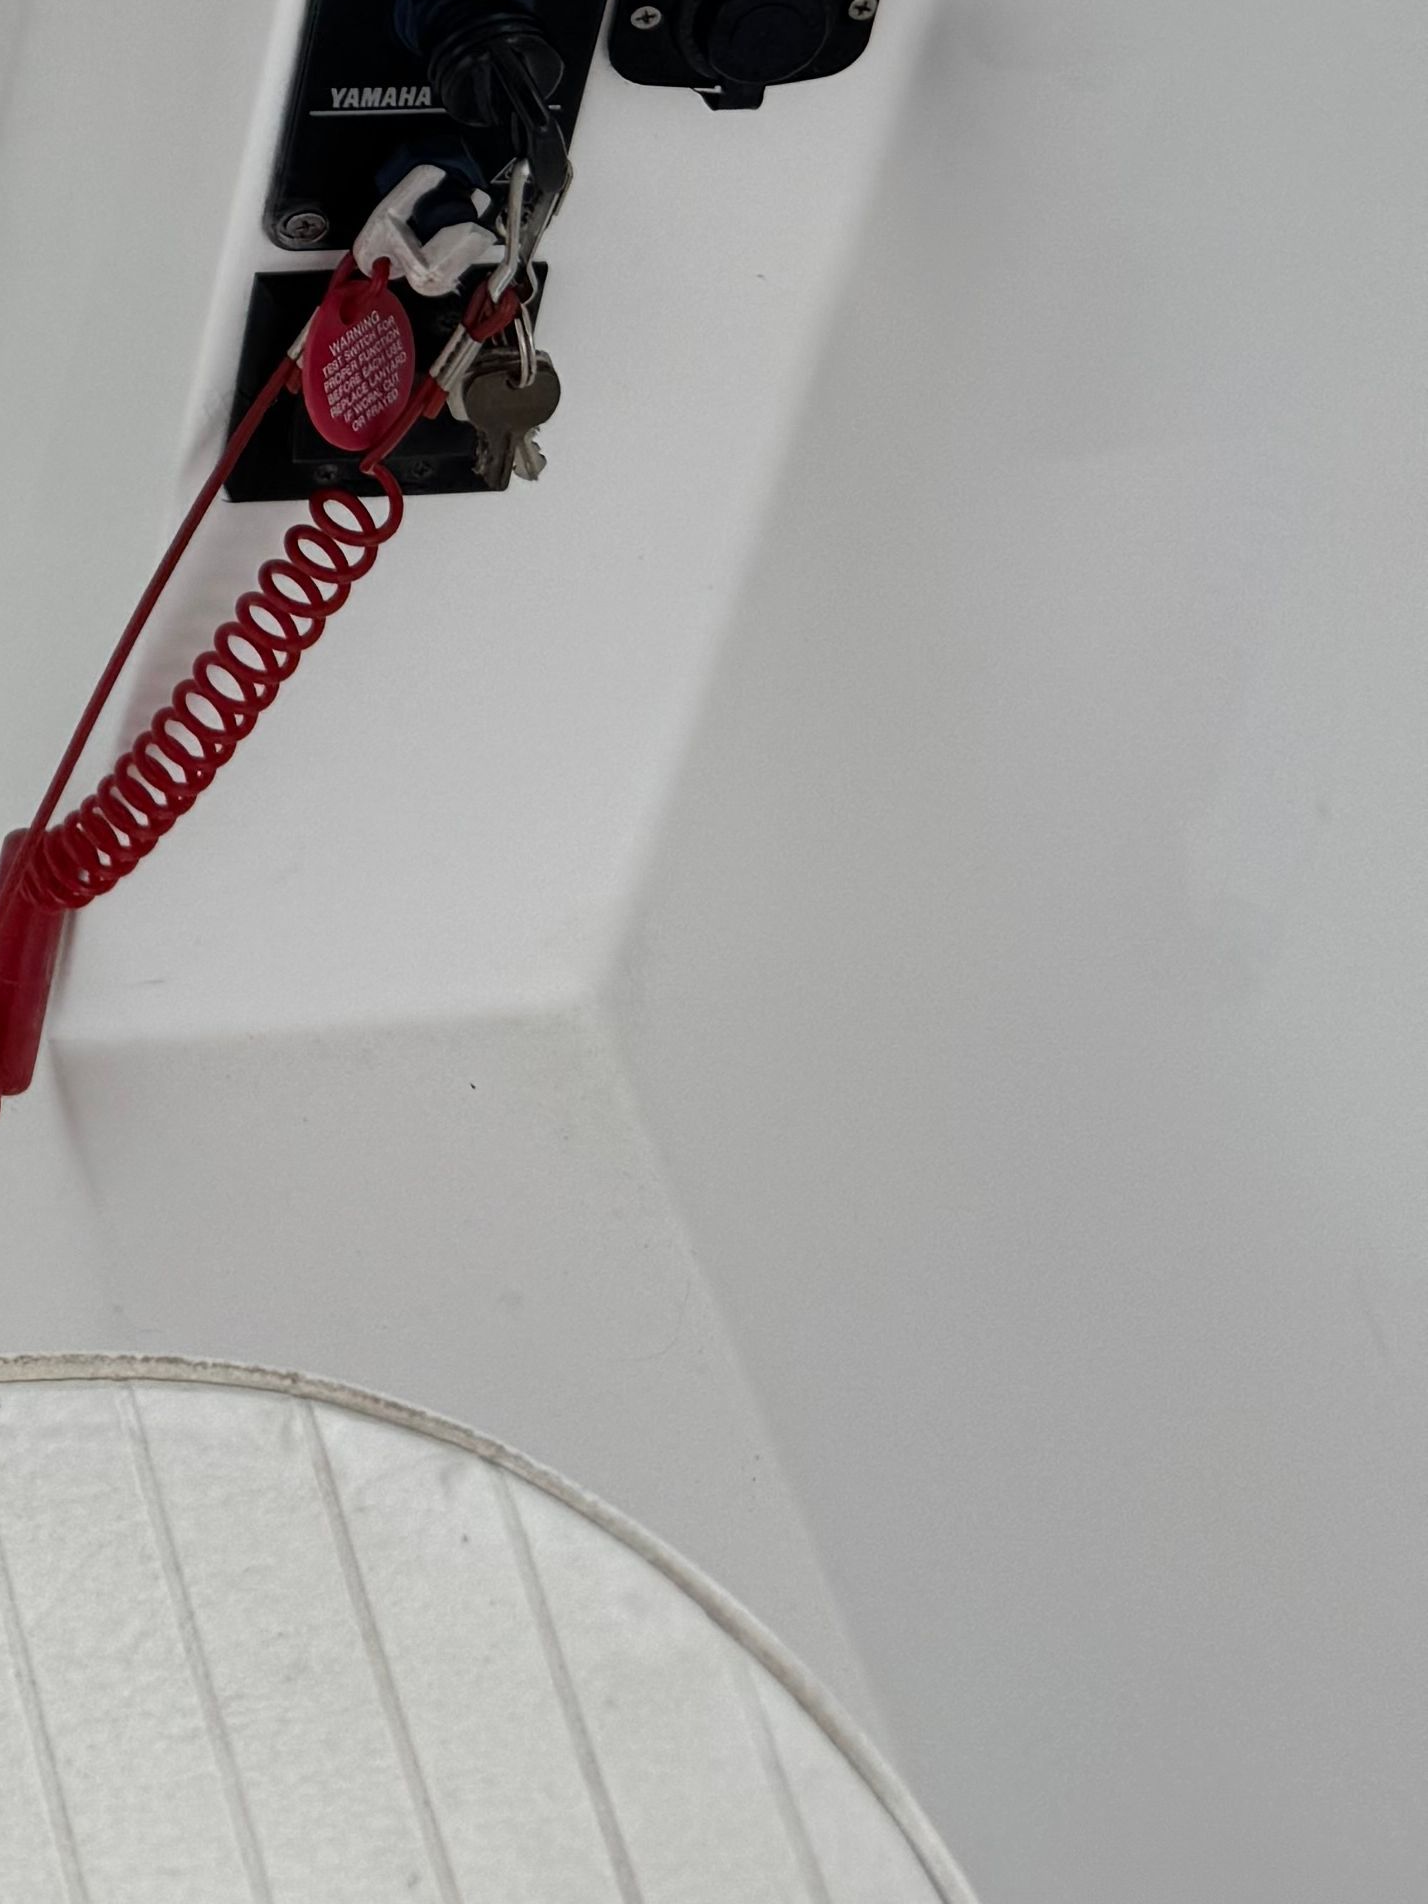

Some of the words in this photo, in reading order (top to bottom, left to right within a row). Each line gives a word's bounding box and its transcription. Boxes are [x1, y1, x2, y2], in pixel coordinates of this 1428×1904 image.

[331, 86, 432, 109] YAMAHA
[322, 356, 345, 379] TEST
[344, 331, 377, 362] SWITCH
[376, 315, 396, 335] FOR
[328, 310, 380, 357] WARNING
[324, 361, 360, 394] PROPER
[358, 329, 400, 364] FUNCTION
[327, 372, 362, 406] BEFORE
[362, 355, 386, 378] EACH
[385, 339, 403, 359] USE
[330, 382, 369, 419] REPLACE
[368, 351, 407, 387] LANYARD
[382, 372, 400, 392] CUT
[352, 415, 367, 432] OR
[365, 388, 399, 419] FRAYED
